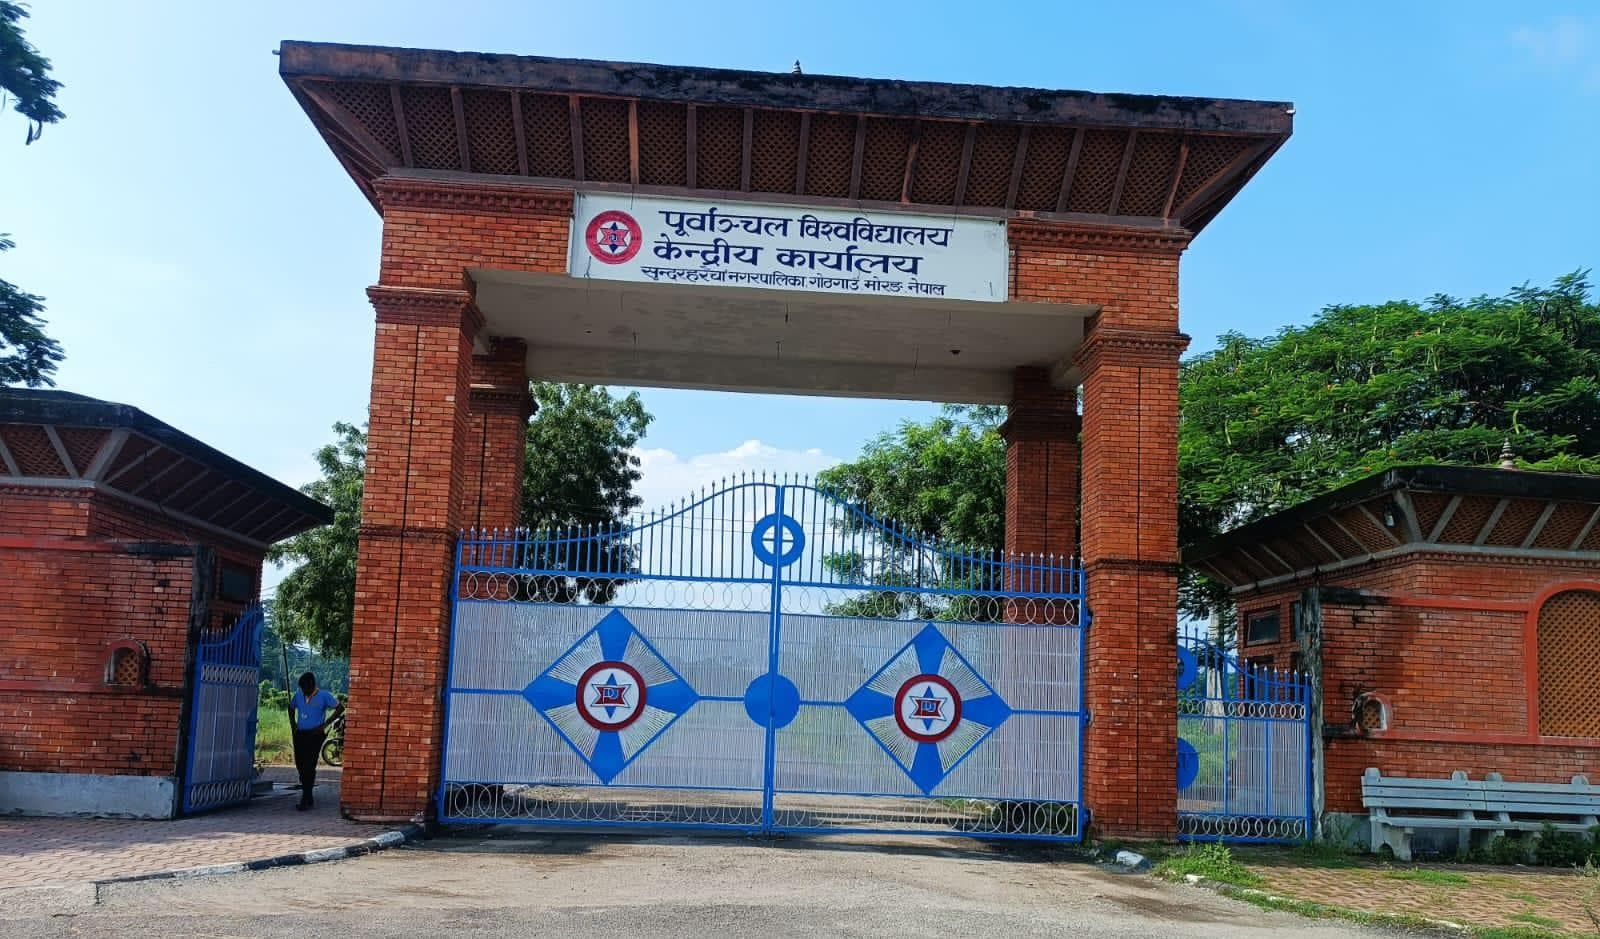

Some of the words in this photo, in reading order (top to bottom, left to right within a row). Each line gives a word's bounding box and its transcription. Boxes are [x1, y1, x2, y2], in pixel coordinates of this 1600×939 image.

[797, 214, 953, 247] विश्वविद्यालय
[653, 233, 764, 266] केन्द्रीय
[776, 245, 923, 275] कार्यालय
